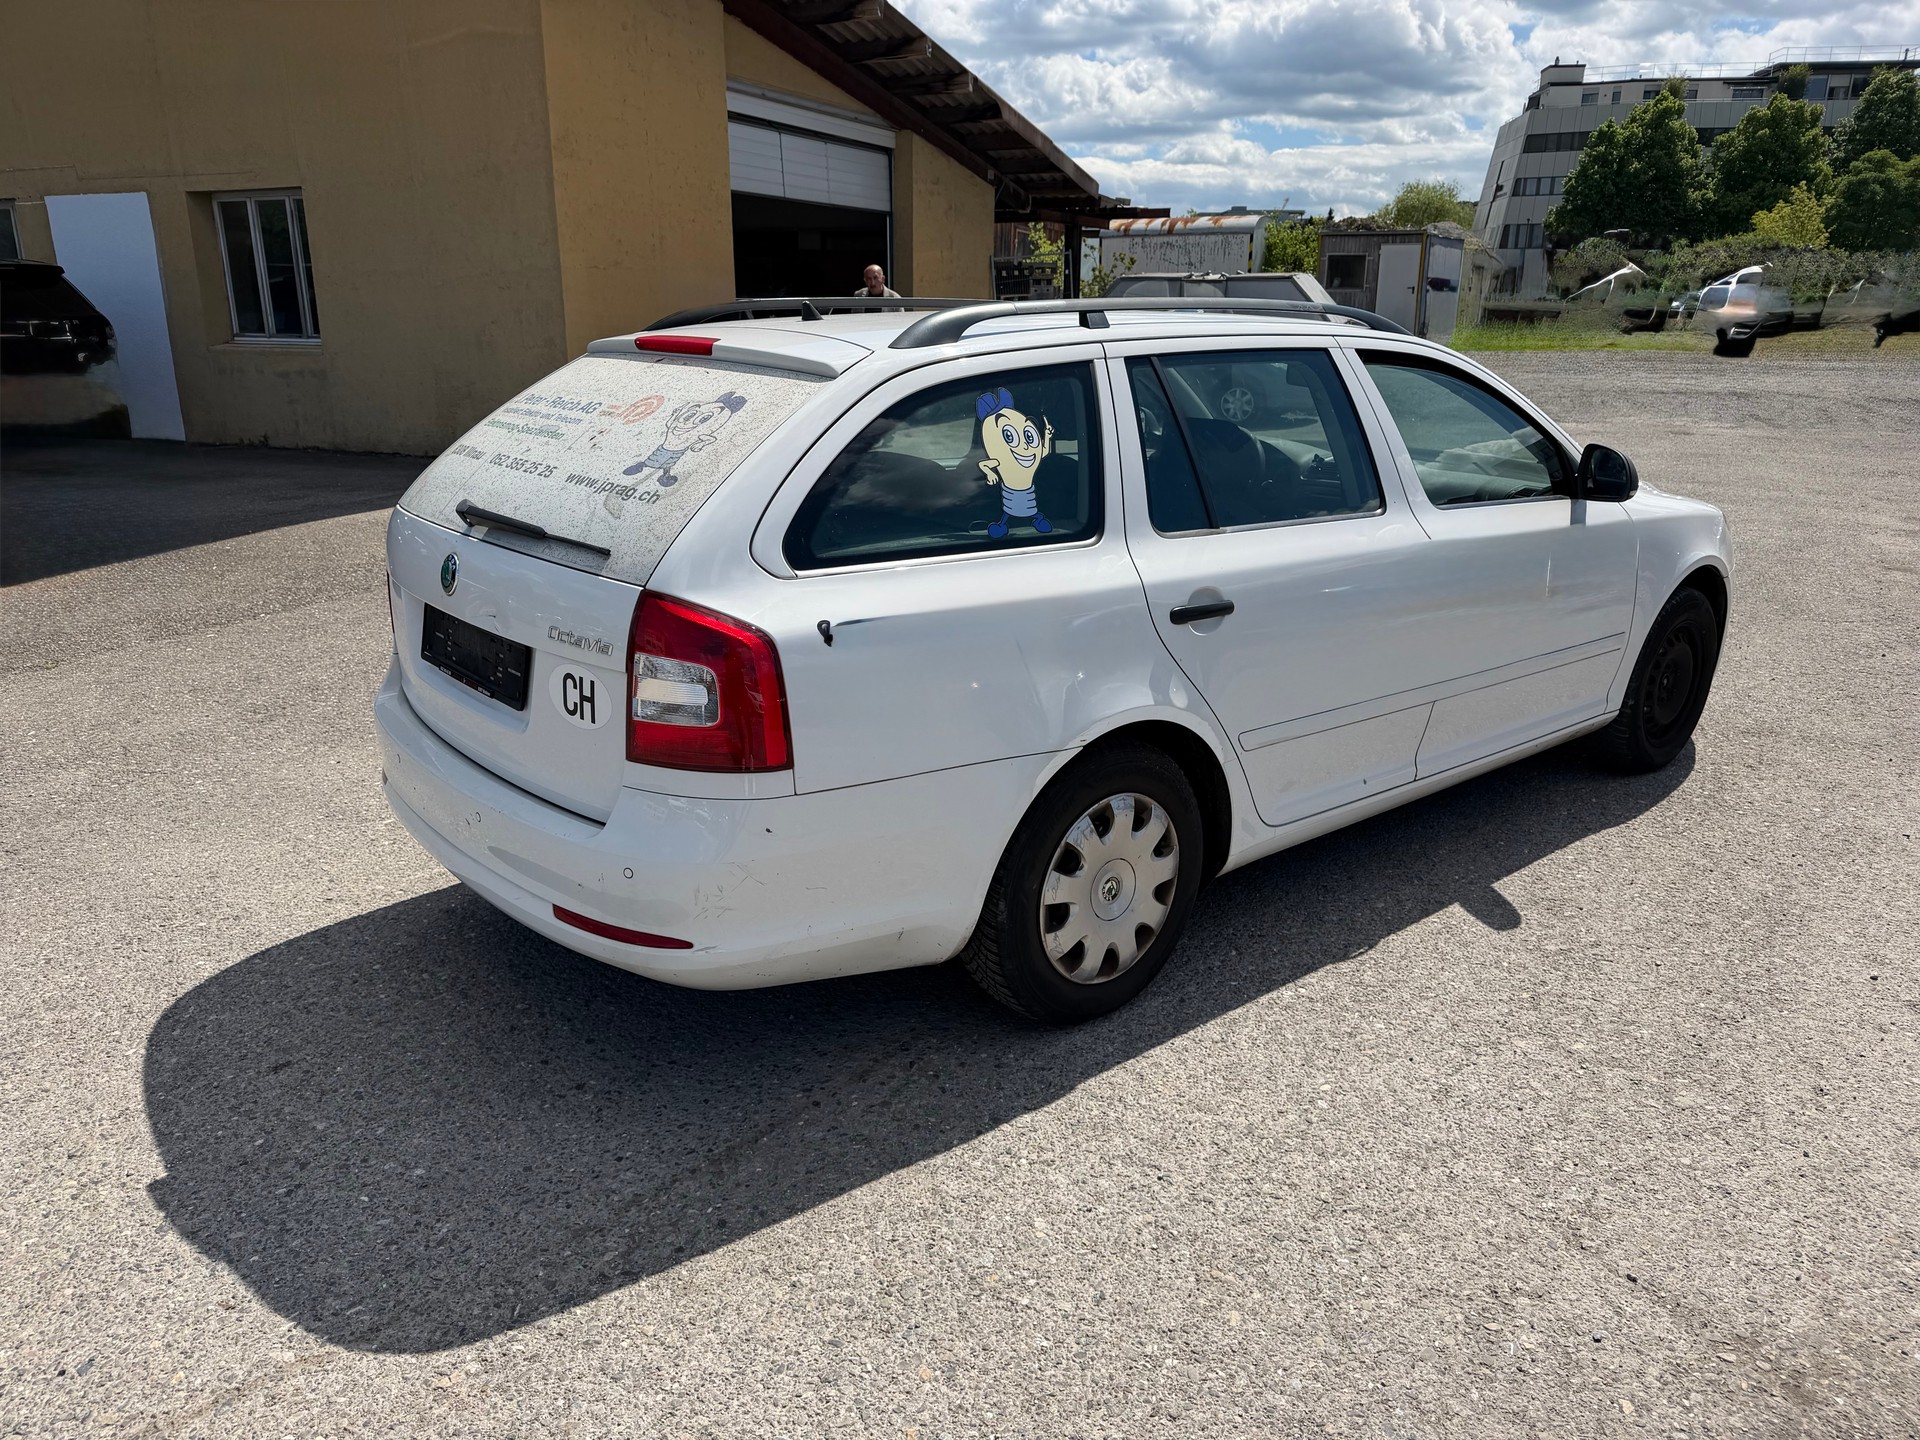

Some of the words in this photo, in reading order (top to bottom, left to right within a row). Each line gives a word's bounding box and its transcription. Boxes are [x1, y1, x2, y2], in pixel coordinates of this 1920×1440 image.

[576, 401, 603, 414] AG
[489, 453, 510, 467] 052
[505, 457, 528, 471] 355
[523, 461, 543, 474] 25
[537, 465, 558, 478] 25
[564, 473, 661, 504] www.jprag.ch
[548, 626, 613, 656] Octavia
[562, 672, 596, 724] CH
